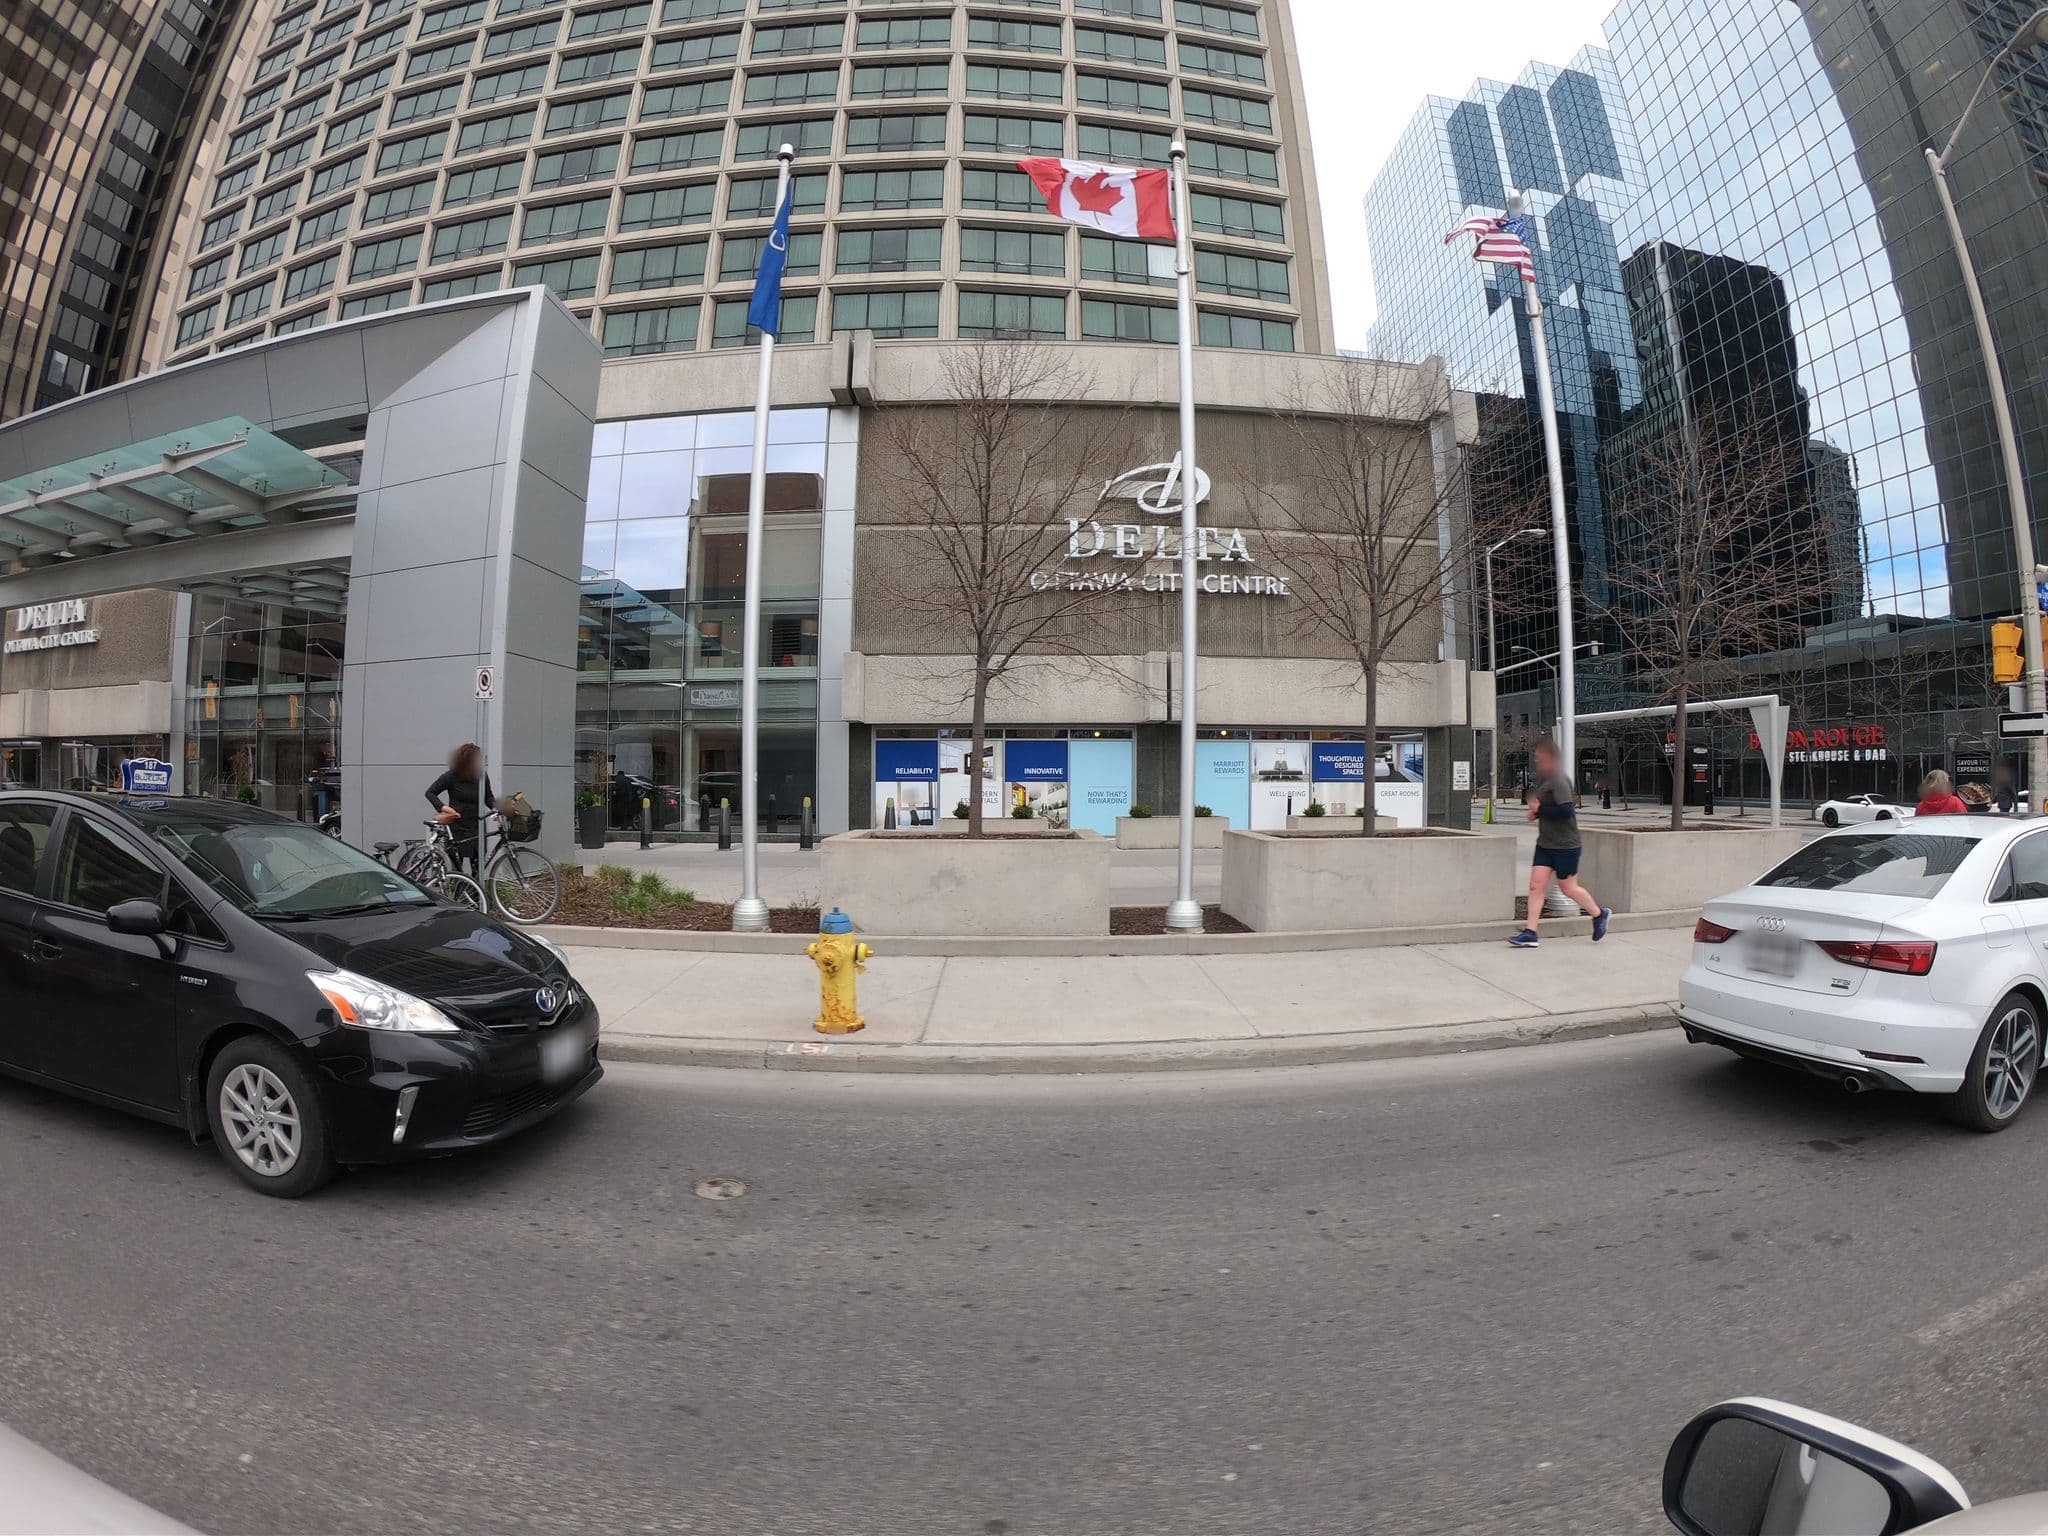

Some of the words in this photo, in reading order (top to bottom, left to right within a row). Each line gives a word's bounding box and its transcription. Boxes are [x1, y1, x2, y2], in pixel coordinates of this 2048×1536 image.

[1064, 517, 1255, 562] DELTA
[1142, 573, 1183, 592] CIT
[1202, 574, 1291, 595] CENTRE
[16, 598, 87, 632] DELTA
[4, 637, 39, 654] OTTAWA
[40, 633, 60, 649] CITY
[61, 629, 100, 646] CENTRE
[1854, 750, 1861, 762] &
[1865, 749, 1886, 762] BAR
[895, 767, 933, 775] RELIABILITY
[1024, 767, 1064, 775] INNOVATIVE
